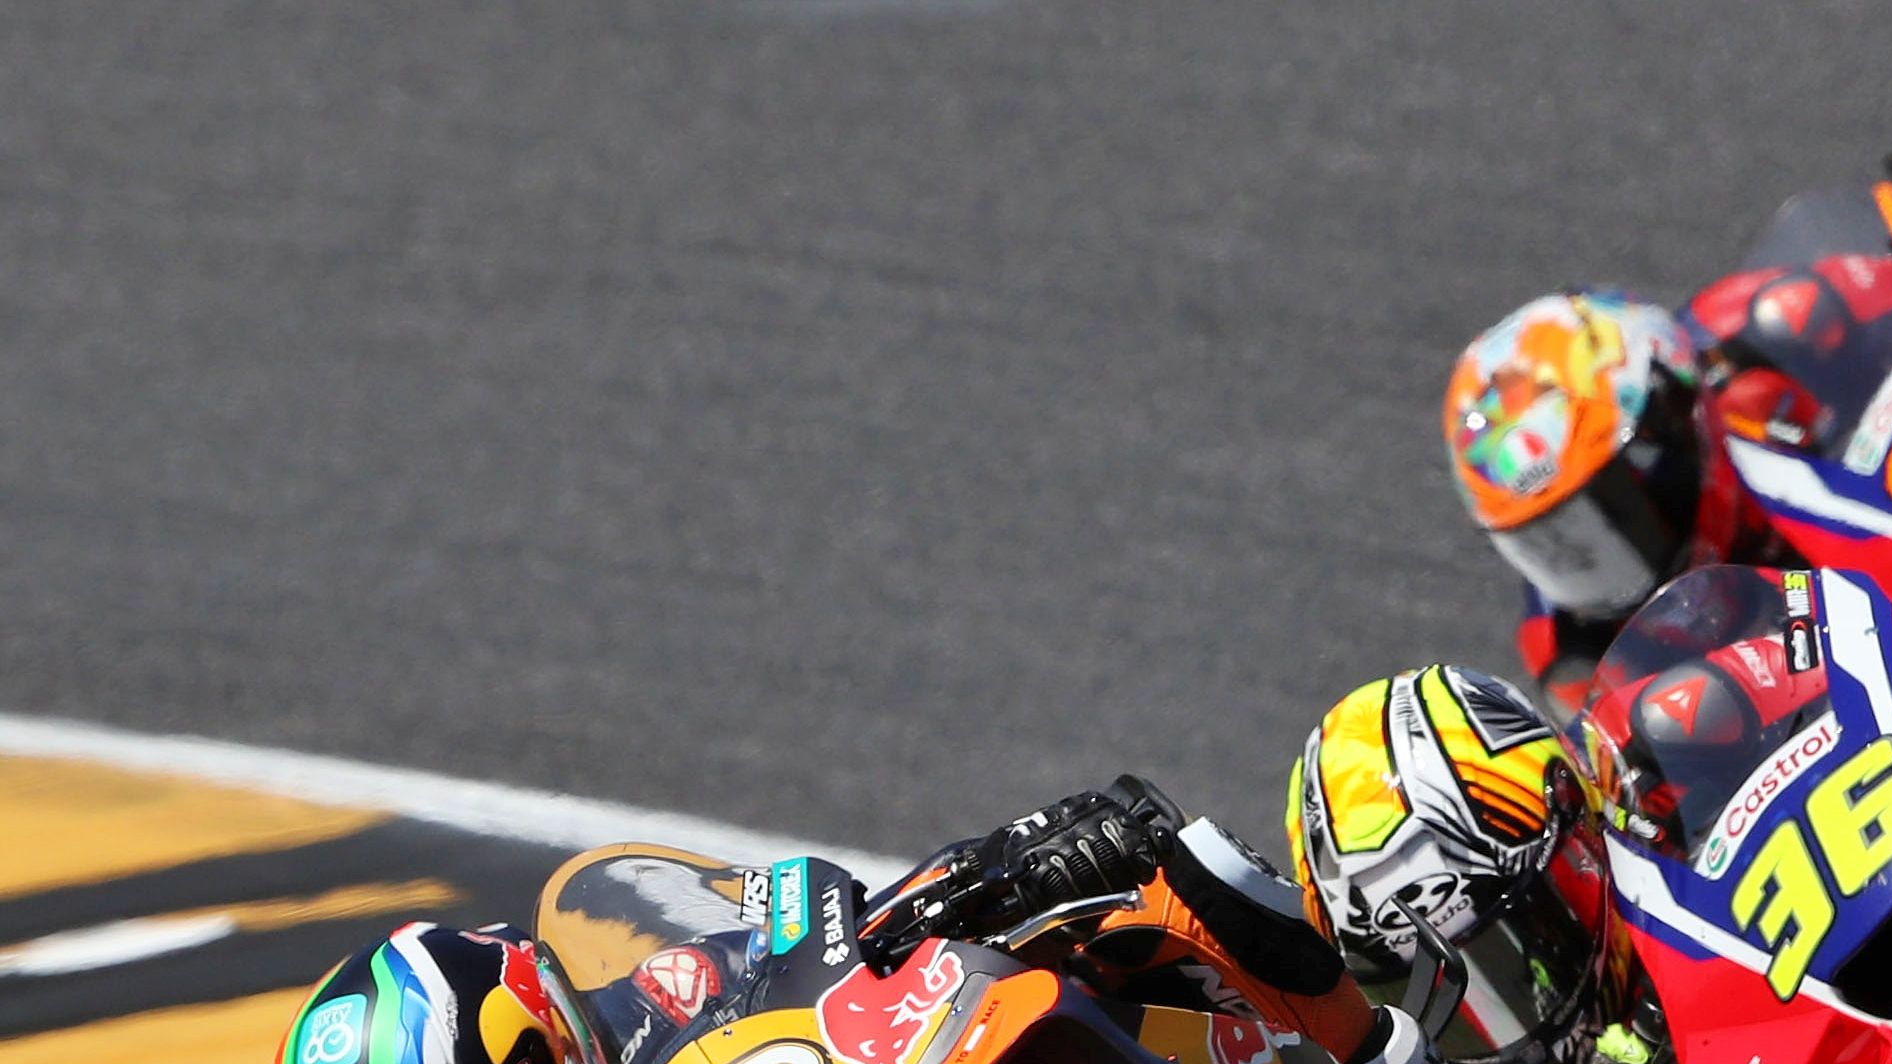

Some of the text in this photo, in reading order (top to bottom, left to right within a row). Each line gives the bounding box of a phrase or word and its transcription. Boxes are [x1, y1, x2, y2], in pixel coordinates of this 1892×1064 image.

[1726, 726, 1833, 838] Castrol
[741, 870, 770, 926] WRS
[822, 885, 844, 945] BAJAJ
[1389, 898, 1470, 949] Kauto
